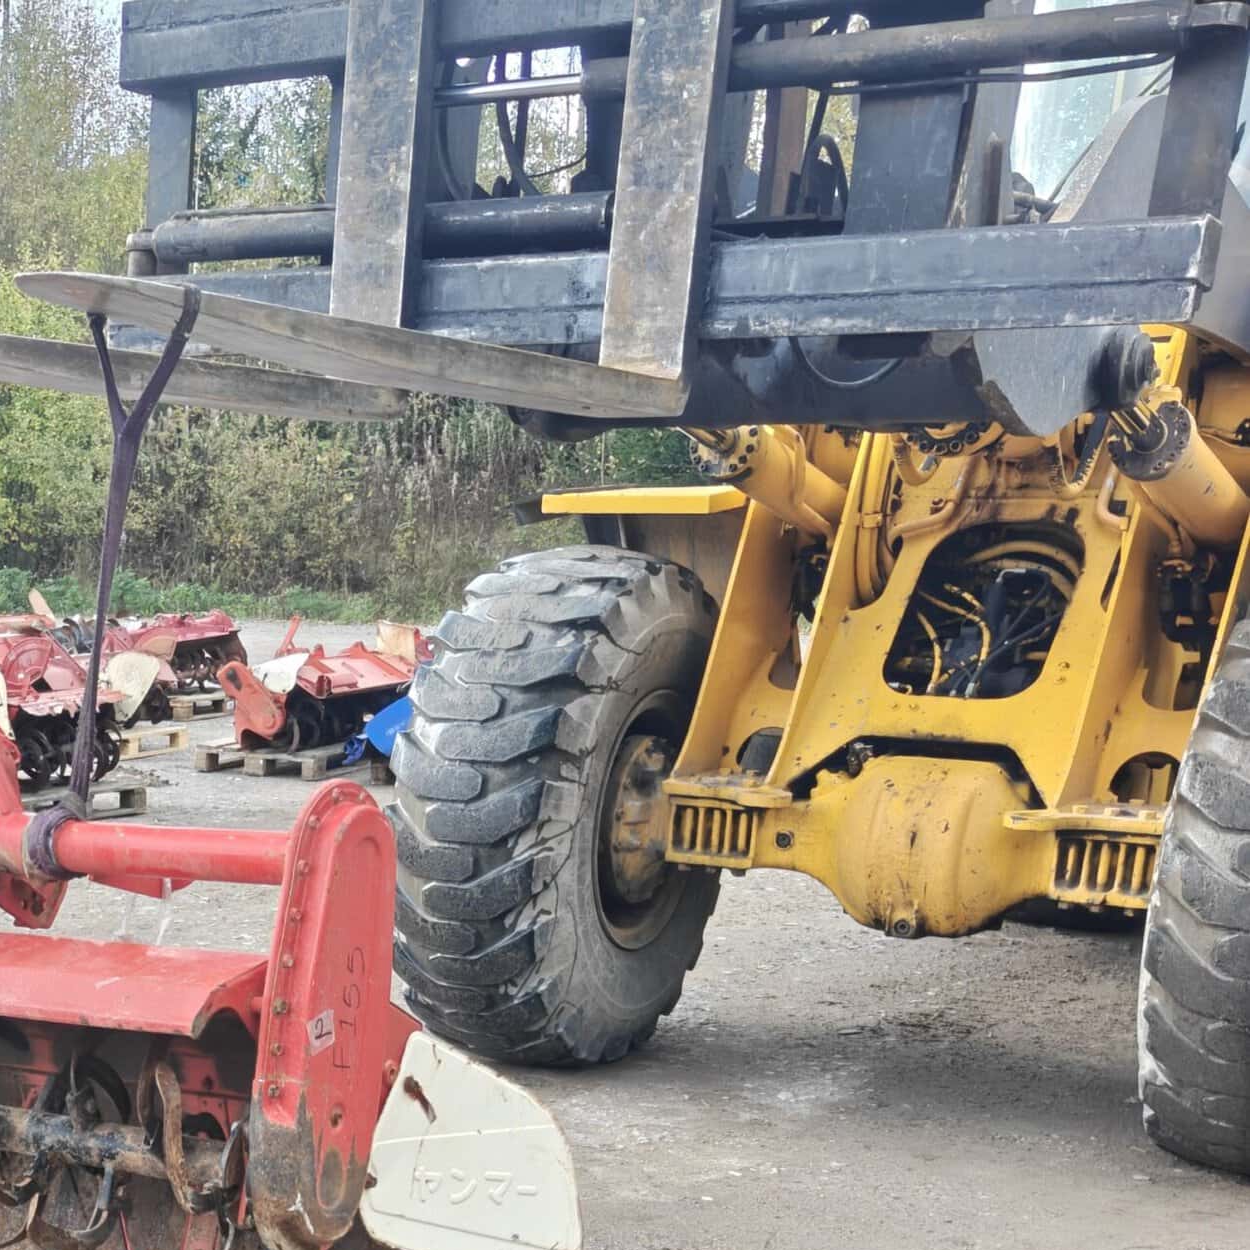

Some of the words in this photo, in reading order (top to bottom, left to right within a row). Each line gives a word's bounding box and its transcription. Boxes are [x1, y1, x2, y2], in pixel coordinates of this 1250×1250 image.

[314, 1017, 333, 1041] 2
[413, 1165, 539, 1206] ヤンマー
